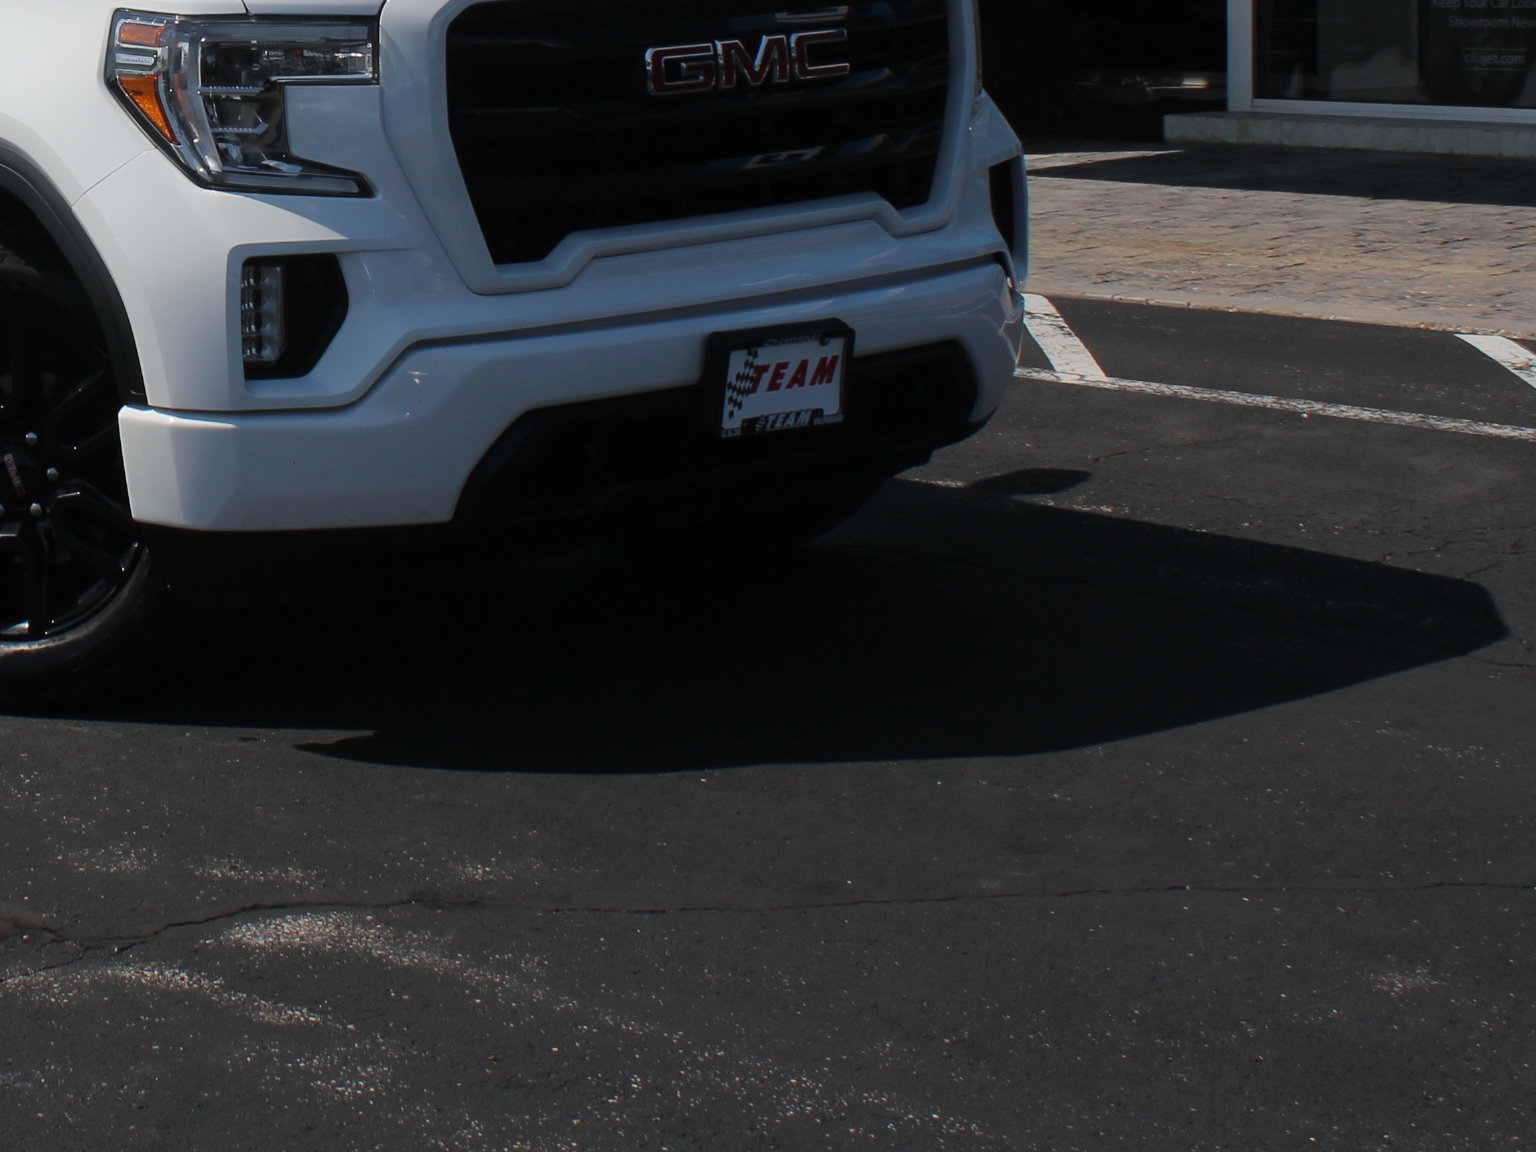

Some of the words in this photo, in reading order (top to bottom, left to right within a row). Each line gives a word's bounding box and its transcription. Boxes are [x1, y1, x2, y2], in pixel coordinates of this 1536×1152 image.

[644, 27, 851, 96] GMC
[749, 354, 840, 394] TEAM
[764, 409, 814, 432] TEAM
